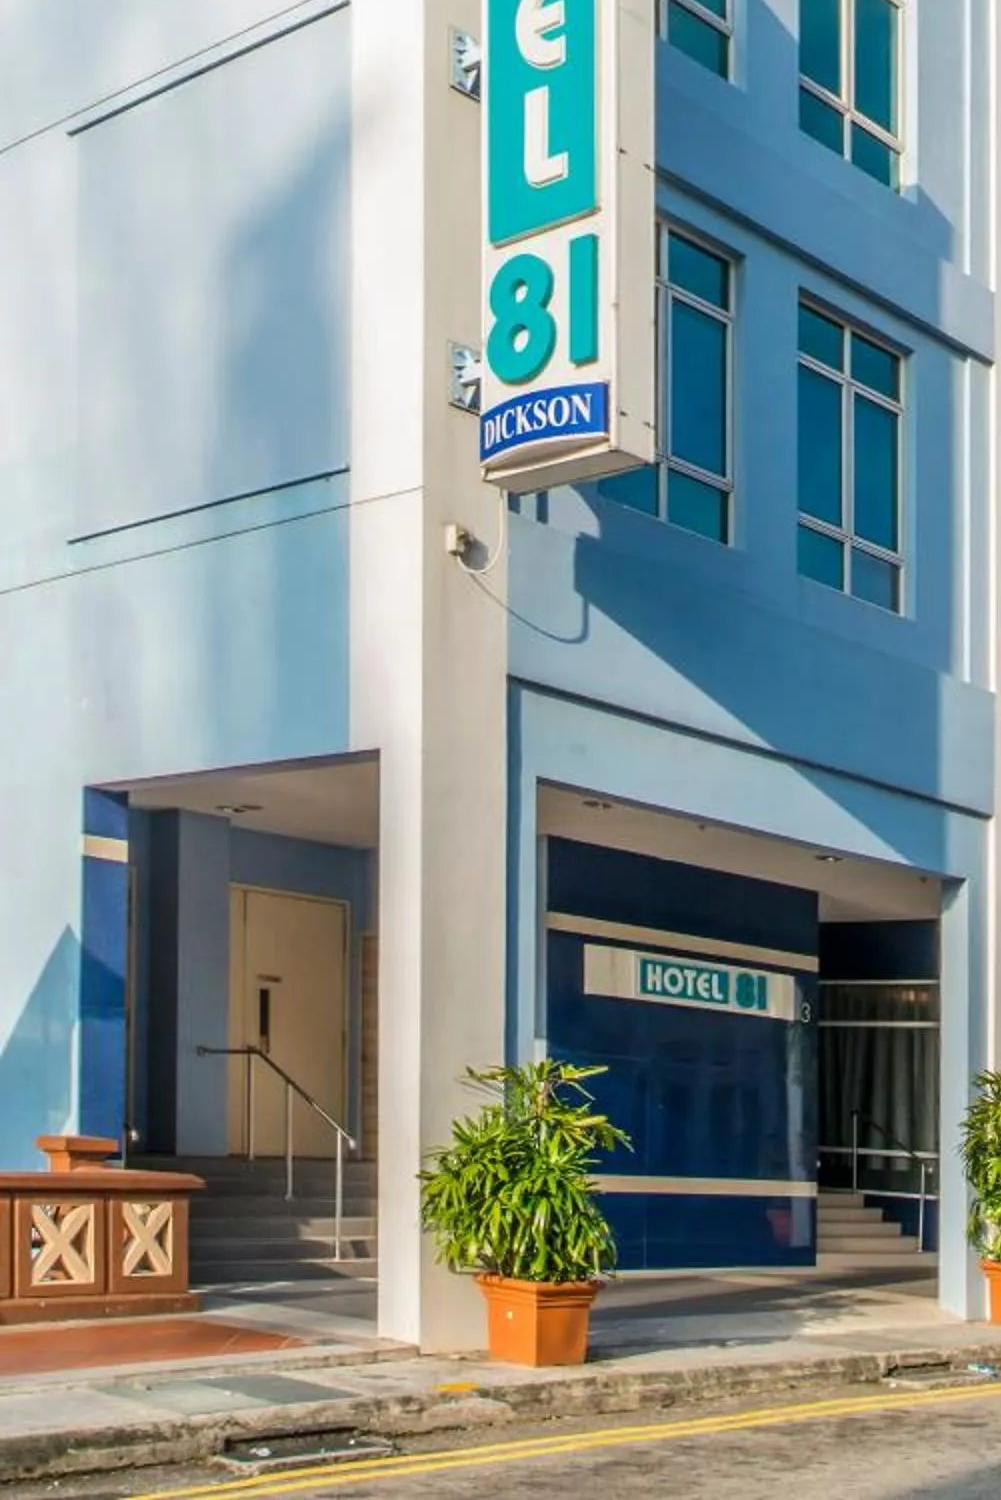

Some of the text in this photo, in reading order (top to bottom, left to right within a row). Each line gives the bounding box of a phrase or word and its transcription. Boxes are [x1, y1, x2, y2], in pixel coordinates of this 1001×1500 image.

[486, 233, 599, 386] 81
[483, 392, 593, 450] DICKSON
[646, 962, 768, 1011] HOTEL 81
